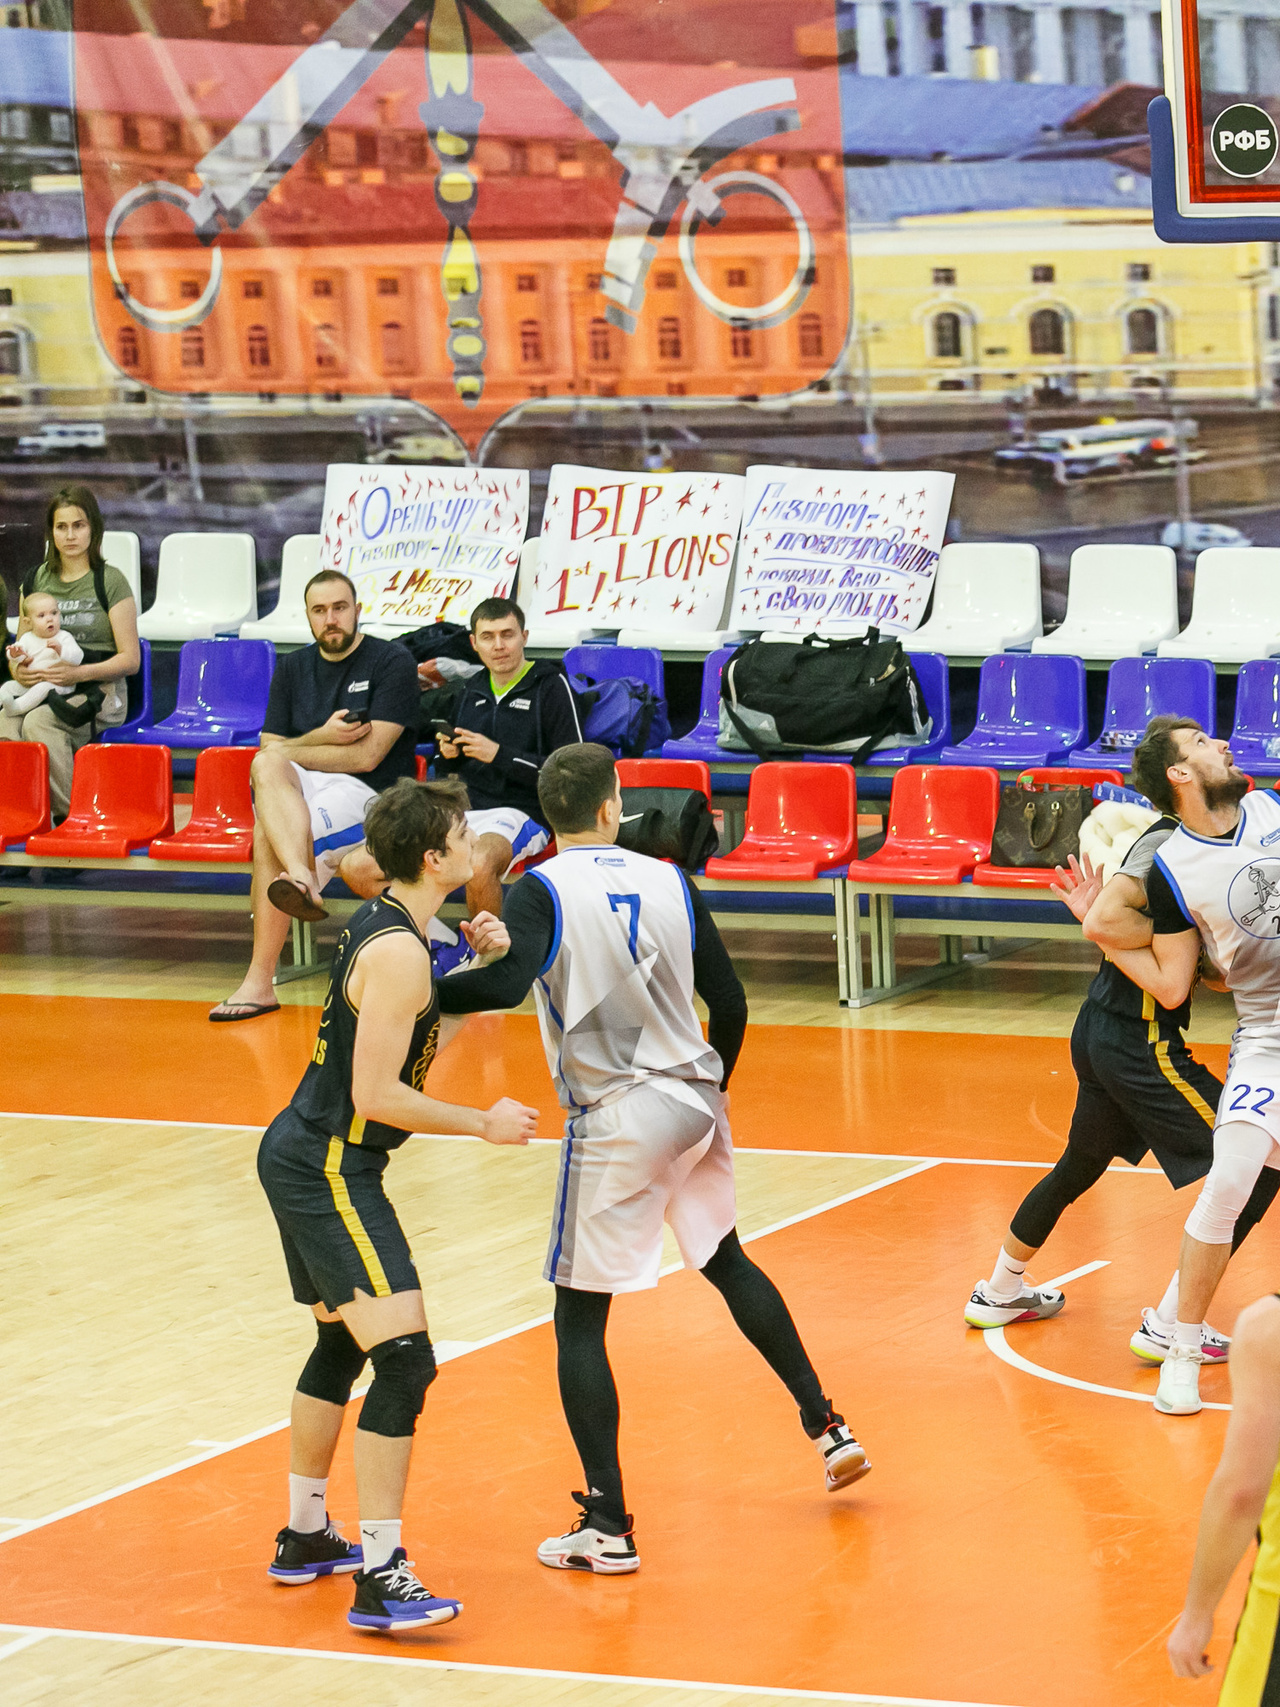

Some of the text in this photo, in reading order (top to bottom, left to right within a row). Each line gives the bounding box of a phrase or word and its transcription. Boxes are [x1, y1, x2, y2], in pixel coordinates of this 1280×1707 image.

[1219, 130, 1271, 151] РФБ
[571, 482, 664, 542] BIP
[614, 532, 733, 586] LIONS
[383, 568, 473, 597] 1 МЕСТО
[606, 892, 641, 965] 7
[1229, 1083, 1275, 1117] 22
